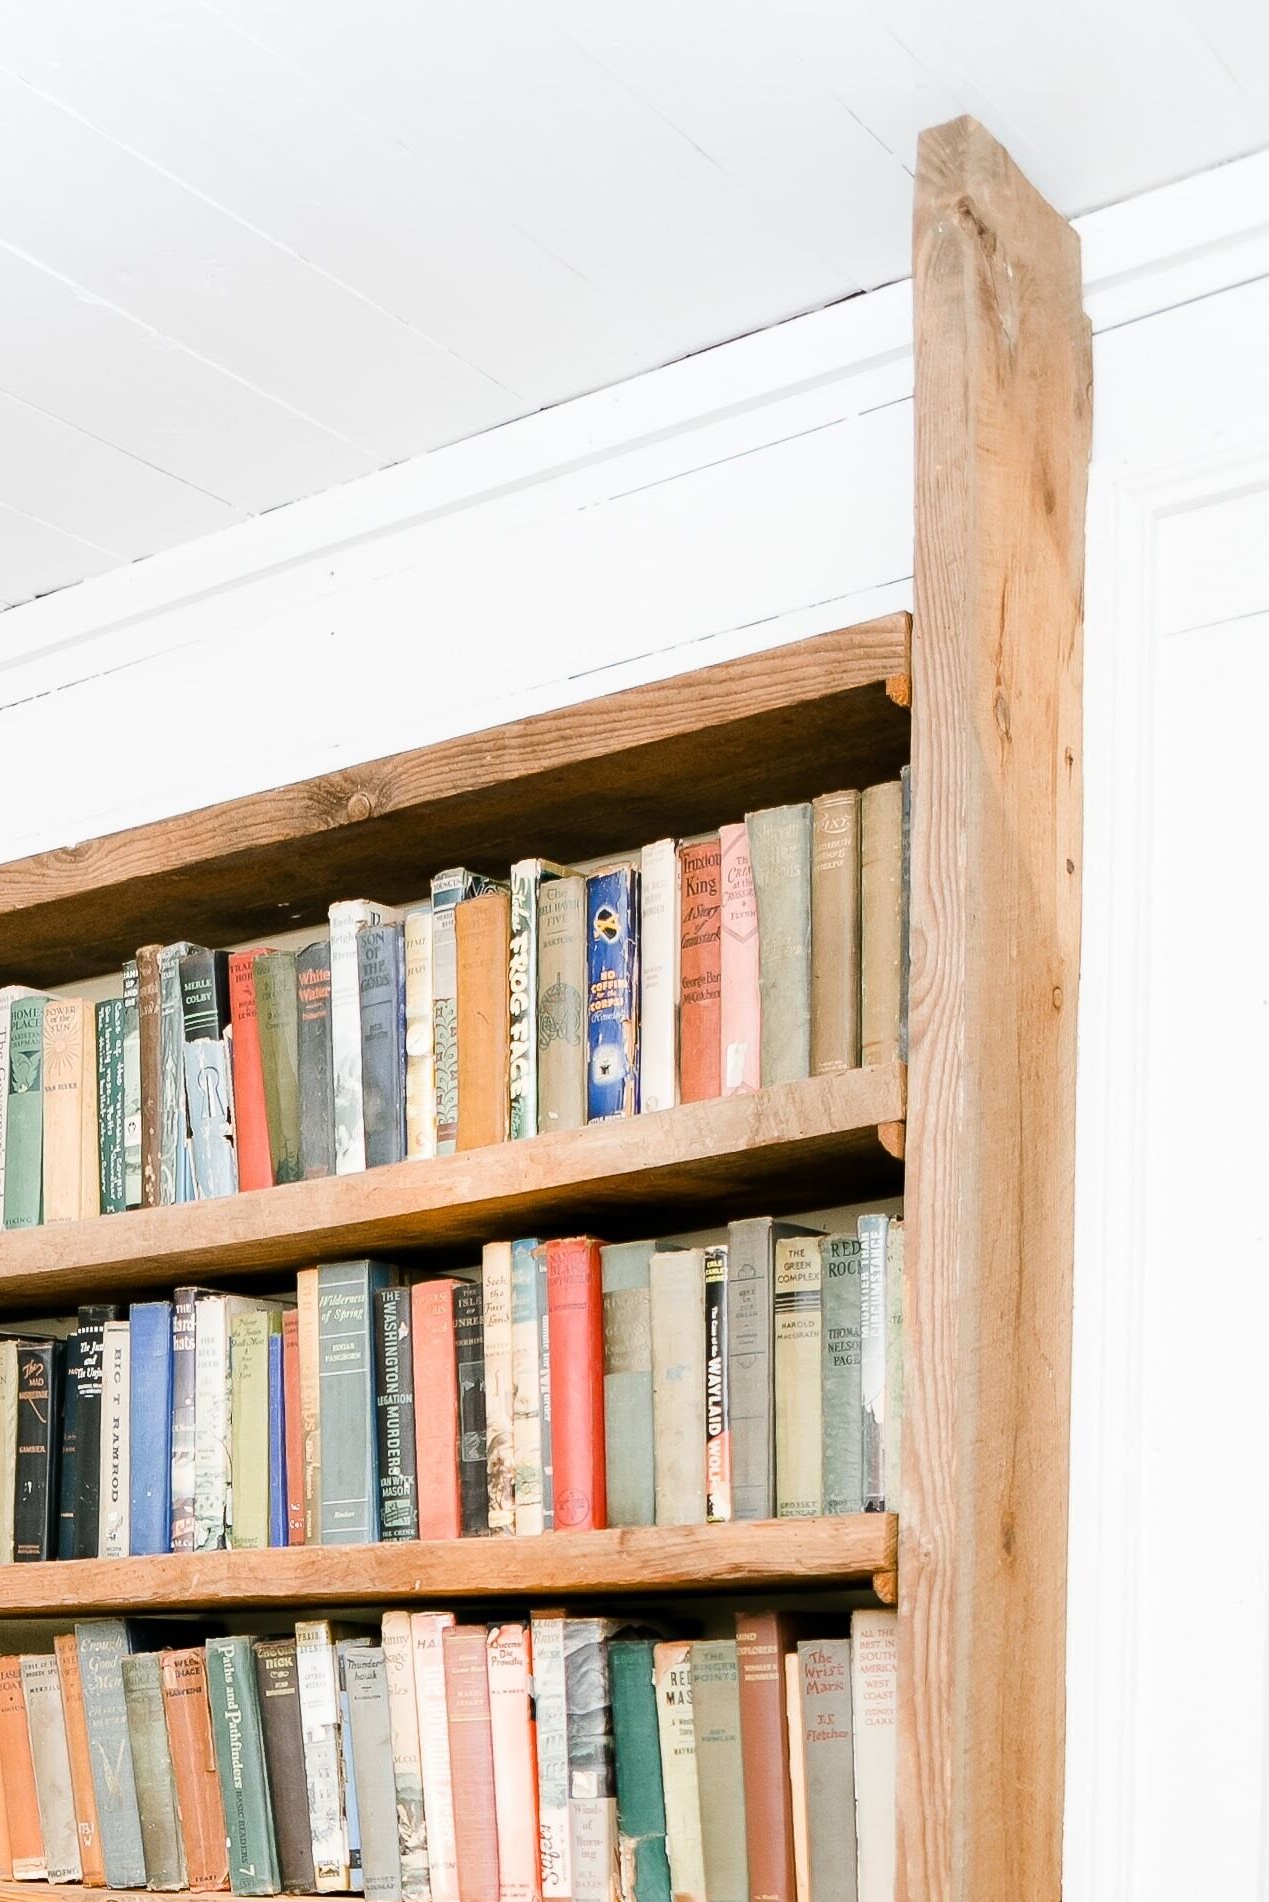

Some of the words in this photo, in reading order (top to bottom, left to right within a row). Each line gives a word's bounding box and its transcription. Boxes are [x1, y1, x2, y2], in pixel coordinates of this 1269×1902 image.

[685, 876, 718, 898] King
[361, 932, 385, 945] SON
[366, 948, 379, 959] OF
[363, 961, 386, 974] THE
[509, 931, 529, 1017] FROG
[298, 969, 331, 985] White
[299, 987, 331, 1001] Water
[510, 1026, 531, 1100] FACE
[788, 1249, 805, 1258] THE
[831, 1240, 862, 1258] RED
[784, 1261, 811, 1272] GREEN
[777, 1272, 820, 1284] COMPLEX
[319, 1292, 365, 1308] Wilderness
[381, 1290, 400, 1302] THE
[322, 1312, 332, 1324] of
[333, 1307, 364, 1322] Spring
[782, 1320, 815, 1330] HAROLD
[332, 1342, 354, 1351] EDGAR
[383, 1302, 400, 1394] WASHINGTON
[84, 1355, 97, 1365] and
[113, 1347, 122, 1384] BIG
[378, 1394, 412, 1406] LEGATION
[708, 1356, 722, 1436] WAYLAID
[112, 1417, 120, 1502] RAMROD
[382, 1484, 410, 1496] MASON
[860, 1629, 875, 1638] ALL
[877, 1629, 894, 1638] THE
[81, 1638, 125, 1653] Enough
[860, 1640, 881, 1649] BEST
[884, 1640, 894, 1648] IN
[500, 1650, 514, 1659] Die
[809, 1650, 832, 1664] The
[859, 1652, 896, 1662] SOUTH
[88, 1657, 119, 1672] Good
[218, 1645, 236, 1684] Paths
[804, 1664, 844, 1678] Wrist
[858, 1664, 897, 1674] AMERICA
[86, 1675, 122, 1690] Men
[864, 1680, 889, 1688] WEST
[226, 1685, 238, 1708] and
[863, 1691, 894, 1700] COAST
[864, 1717, 894, 1726] CLARK
[806, 1730, 848, 1741] Fletcher
[224, 1709, 243, 1789] Pathfinders
[235, 1789, 244, 1817] BASIC
[238, 1819, 248, 1863] READERS
[239, 1864, 255, 1877] 7
